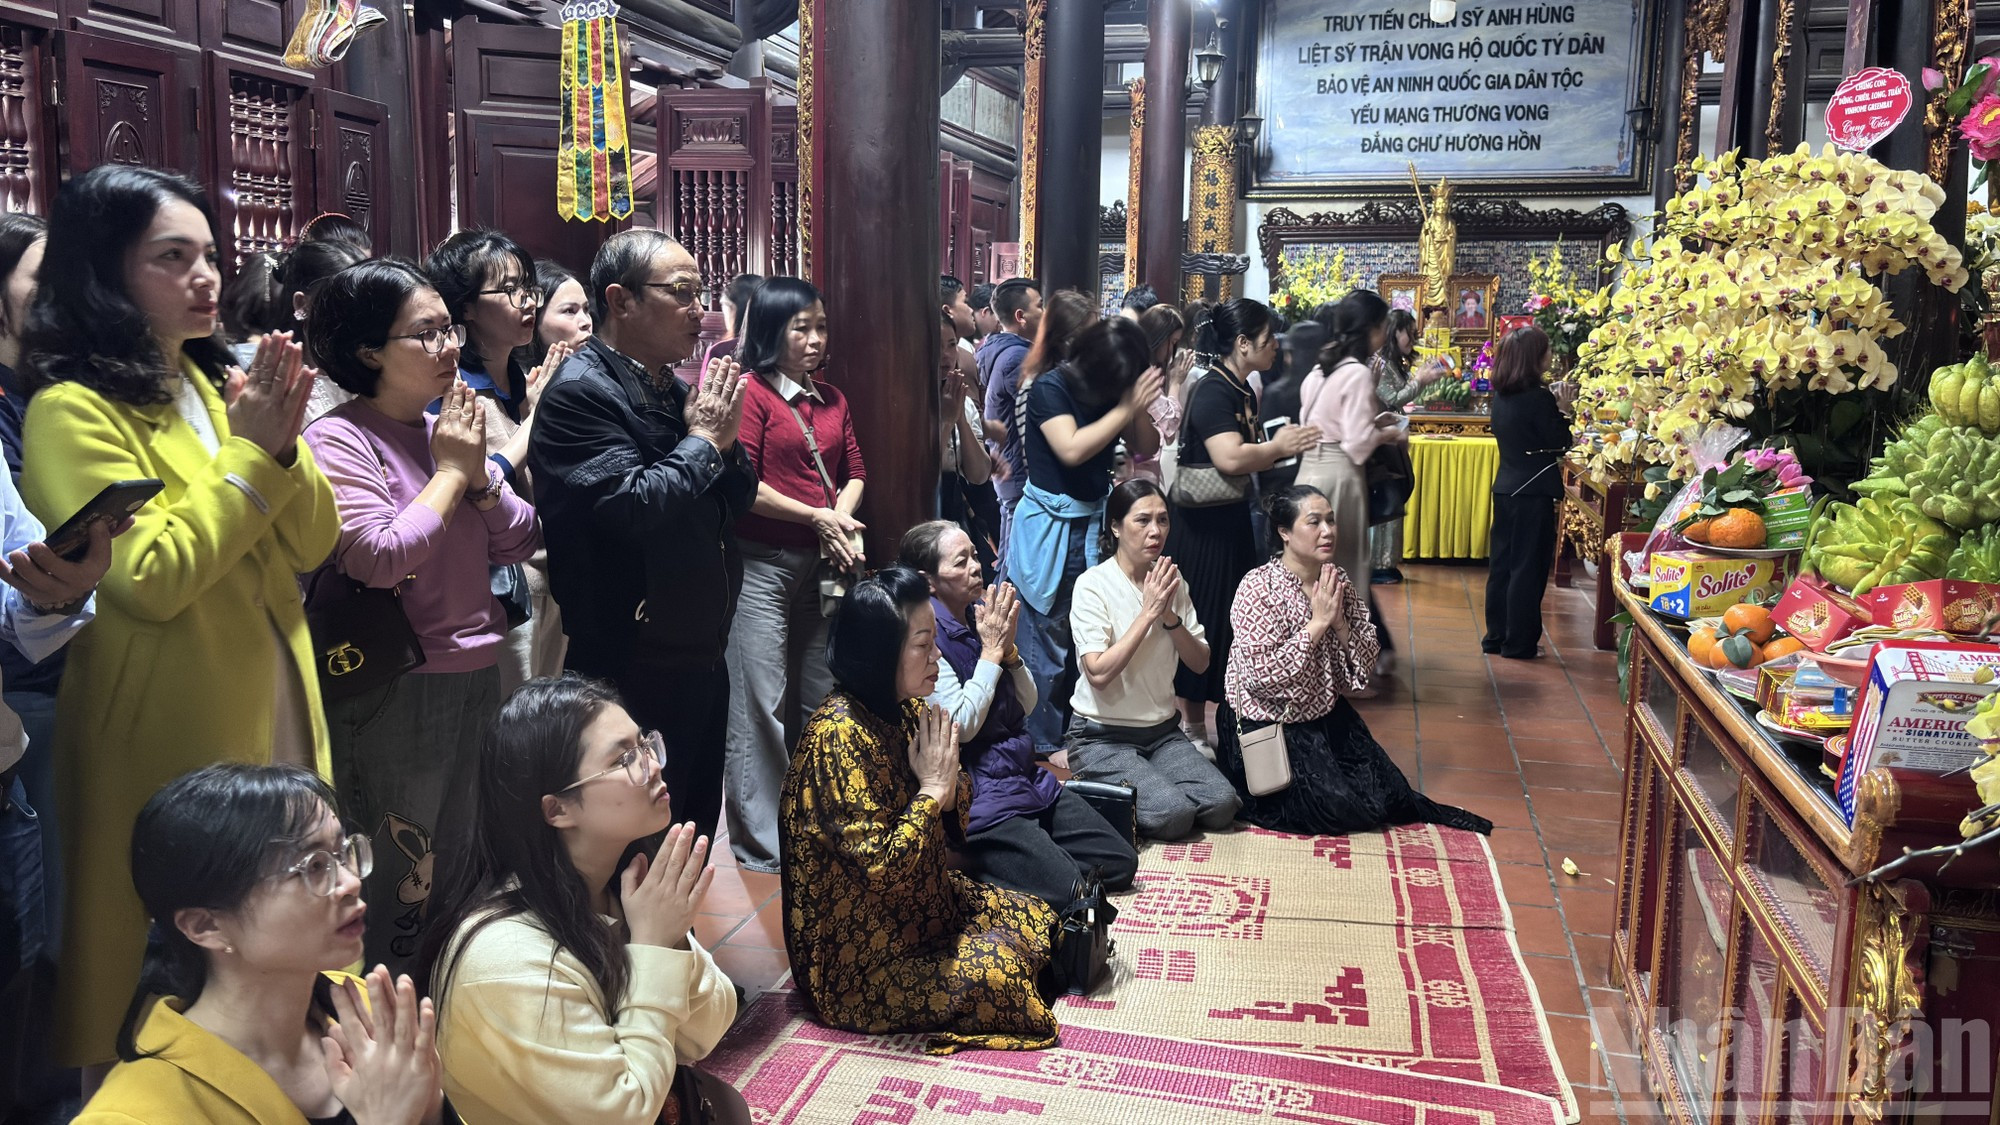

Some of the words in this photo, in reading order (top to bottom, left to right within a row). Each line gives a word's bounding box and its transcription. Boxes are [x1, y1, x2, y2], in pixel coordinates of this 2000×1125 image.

[1323, 14, 1366, 32] TRUY
[1369, 7, 1404, 31] TIẾN
[1408, 11, 1458, 30] CHN
[1461, 6, 1485, 28] SỸ
[1486, 7, 1522, 27] ANH
[1526, 2, 1575, 25] HÙNG
[1298, 42, 1332, 67] LIỆT
[1334, 42, 1357, 63] SỸ
[1360, 40, 1404, 65] TRẬN
[1407, 41, 1454, 60] VONG
[1458, 36, 1483, 62] HỘ
[1487, 32, 1537, 59] QUỐC
[1541, 32, 1565, 56] TÝ
[1567, 32, 1605, 56] DÂN
[1316, 73, 1348, 95] BẢO
[1351, 74, 1370, 96] VỆ
[1372, 76, 1394, 93] AN
[1397, 75, 1434, 93] NINH
[1437, 68, 1481, 92] QUỐC
[1485, 73, 1512, 90] GIA
[1515, 68, 1548, 90] DÂN
[1551, 67, 1584, 92] TỘC
[1350, 103, 1380, 125] YỂU
[1384, 106, 1429, 126] MẠNG
[1432, 103, 1501, 123] THƯƠNG
[1504, 104, 1549, 122] VONG
[1360, 130, 1404, 153] ĐẲNG
[1407, 133, 1443, 153] CHƯ
[1445, 133, 1503, 152] HƯƠNG
[1507, 129, 1542, 151] HỒN
[1655, 566, 1680, 582] Solite
[1696, 569, 1749, 599] Solite
[1888, 716, 1967, 732] AMERIC
[1905, 729, 1972, 740] SIGNATURE
[1892, 736, 1930, 744] BUTTER
[1935, 740, 1980, 748] COOKIES
